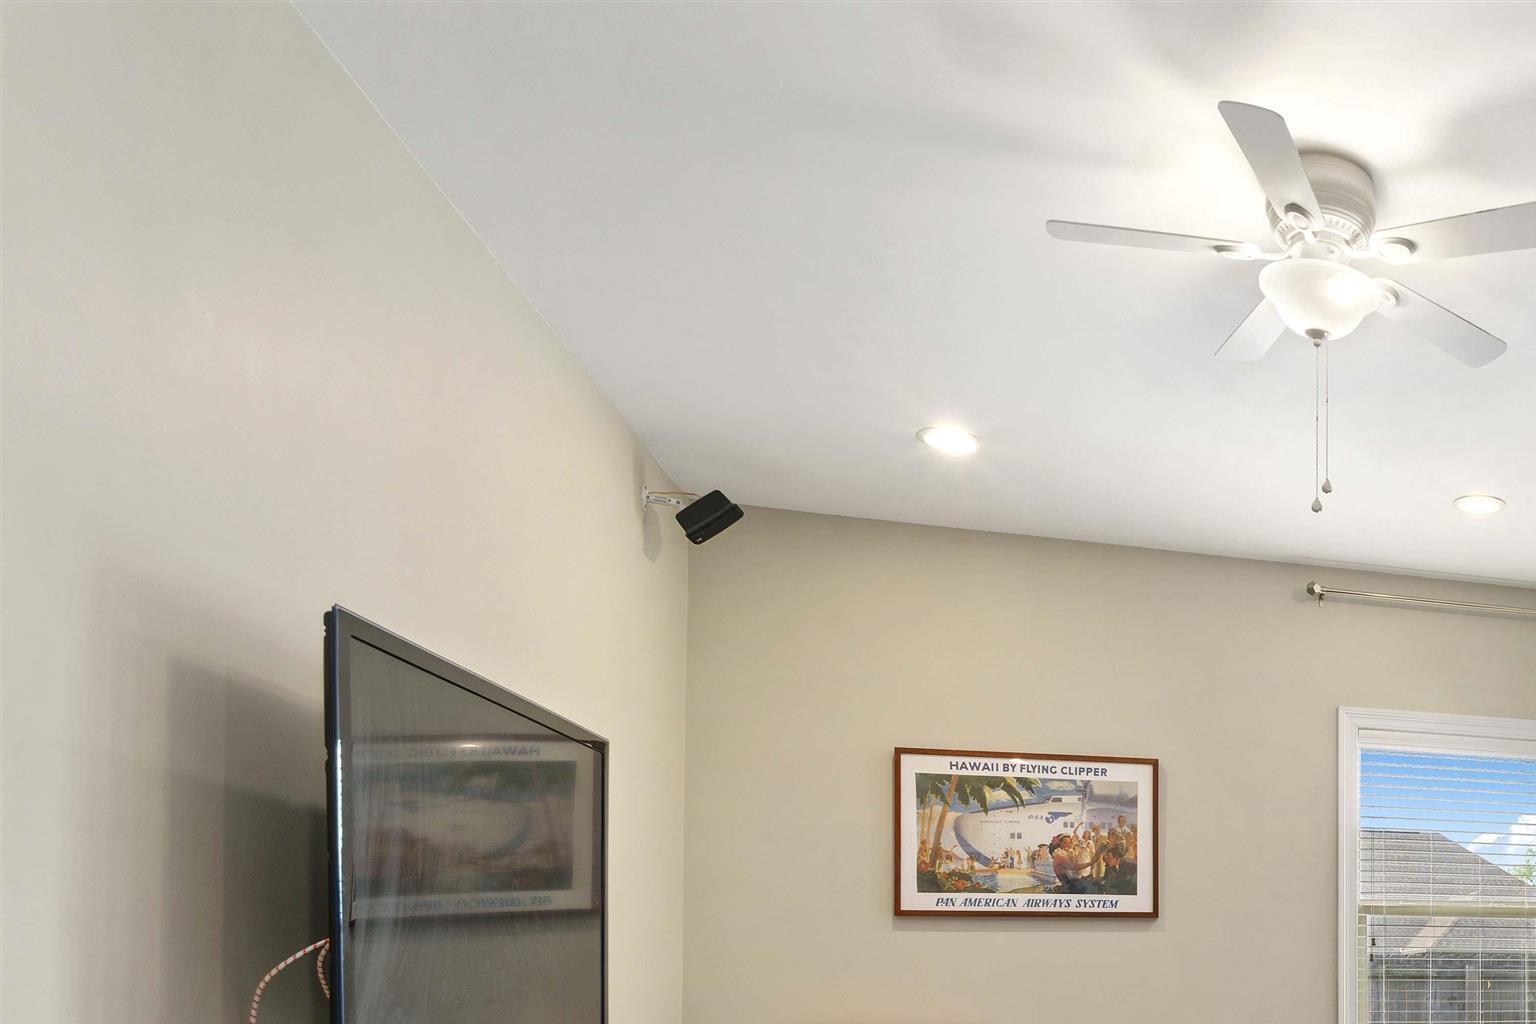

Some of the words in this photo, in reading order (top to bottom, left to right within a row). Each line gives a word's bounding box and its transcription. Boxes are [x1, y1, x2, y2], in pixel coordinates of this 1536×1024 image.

[949, 761, 999, 772] HAWAII
[1002, 763, 1017, 773] BY
[1020, 764, 1057, 775] FLYING
[1060, 766, 1108, 777] CLIPPER
[935, 897, 957, 907] PAN
[959, 897, 1019, 908] AMERICAN
[1022, 898, 1072, 909] AIRWAYS
[1075, 899, 1120, 909] SYSTEM
